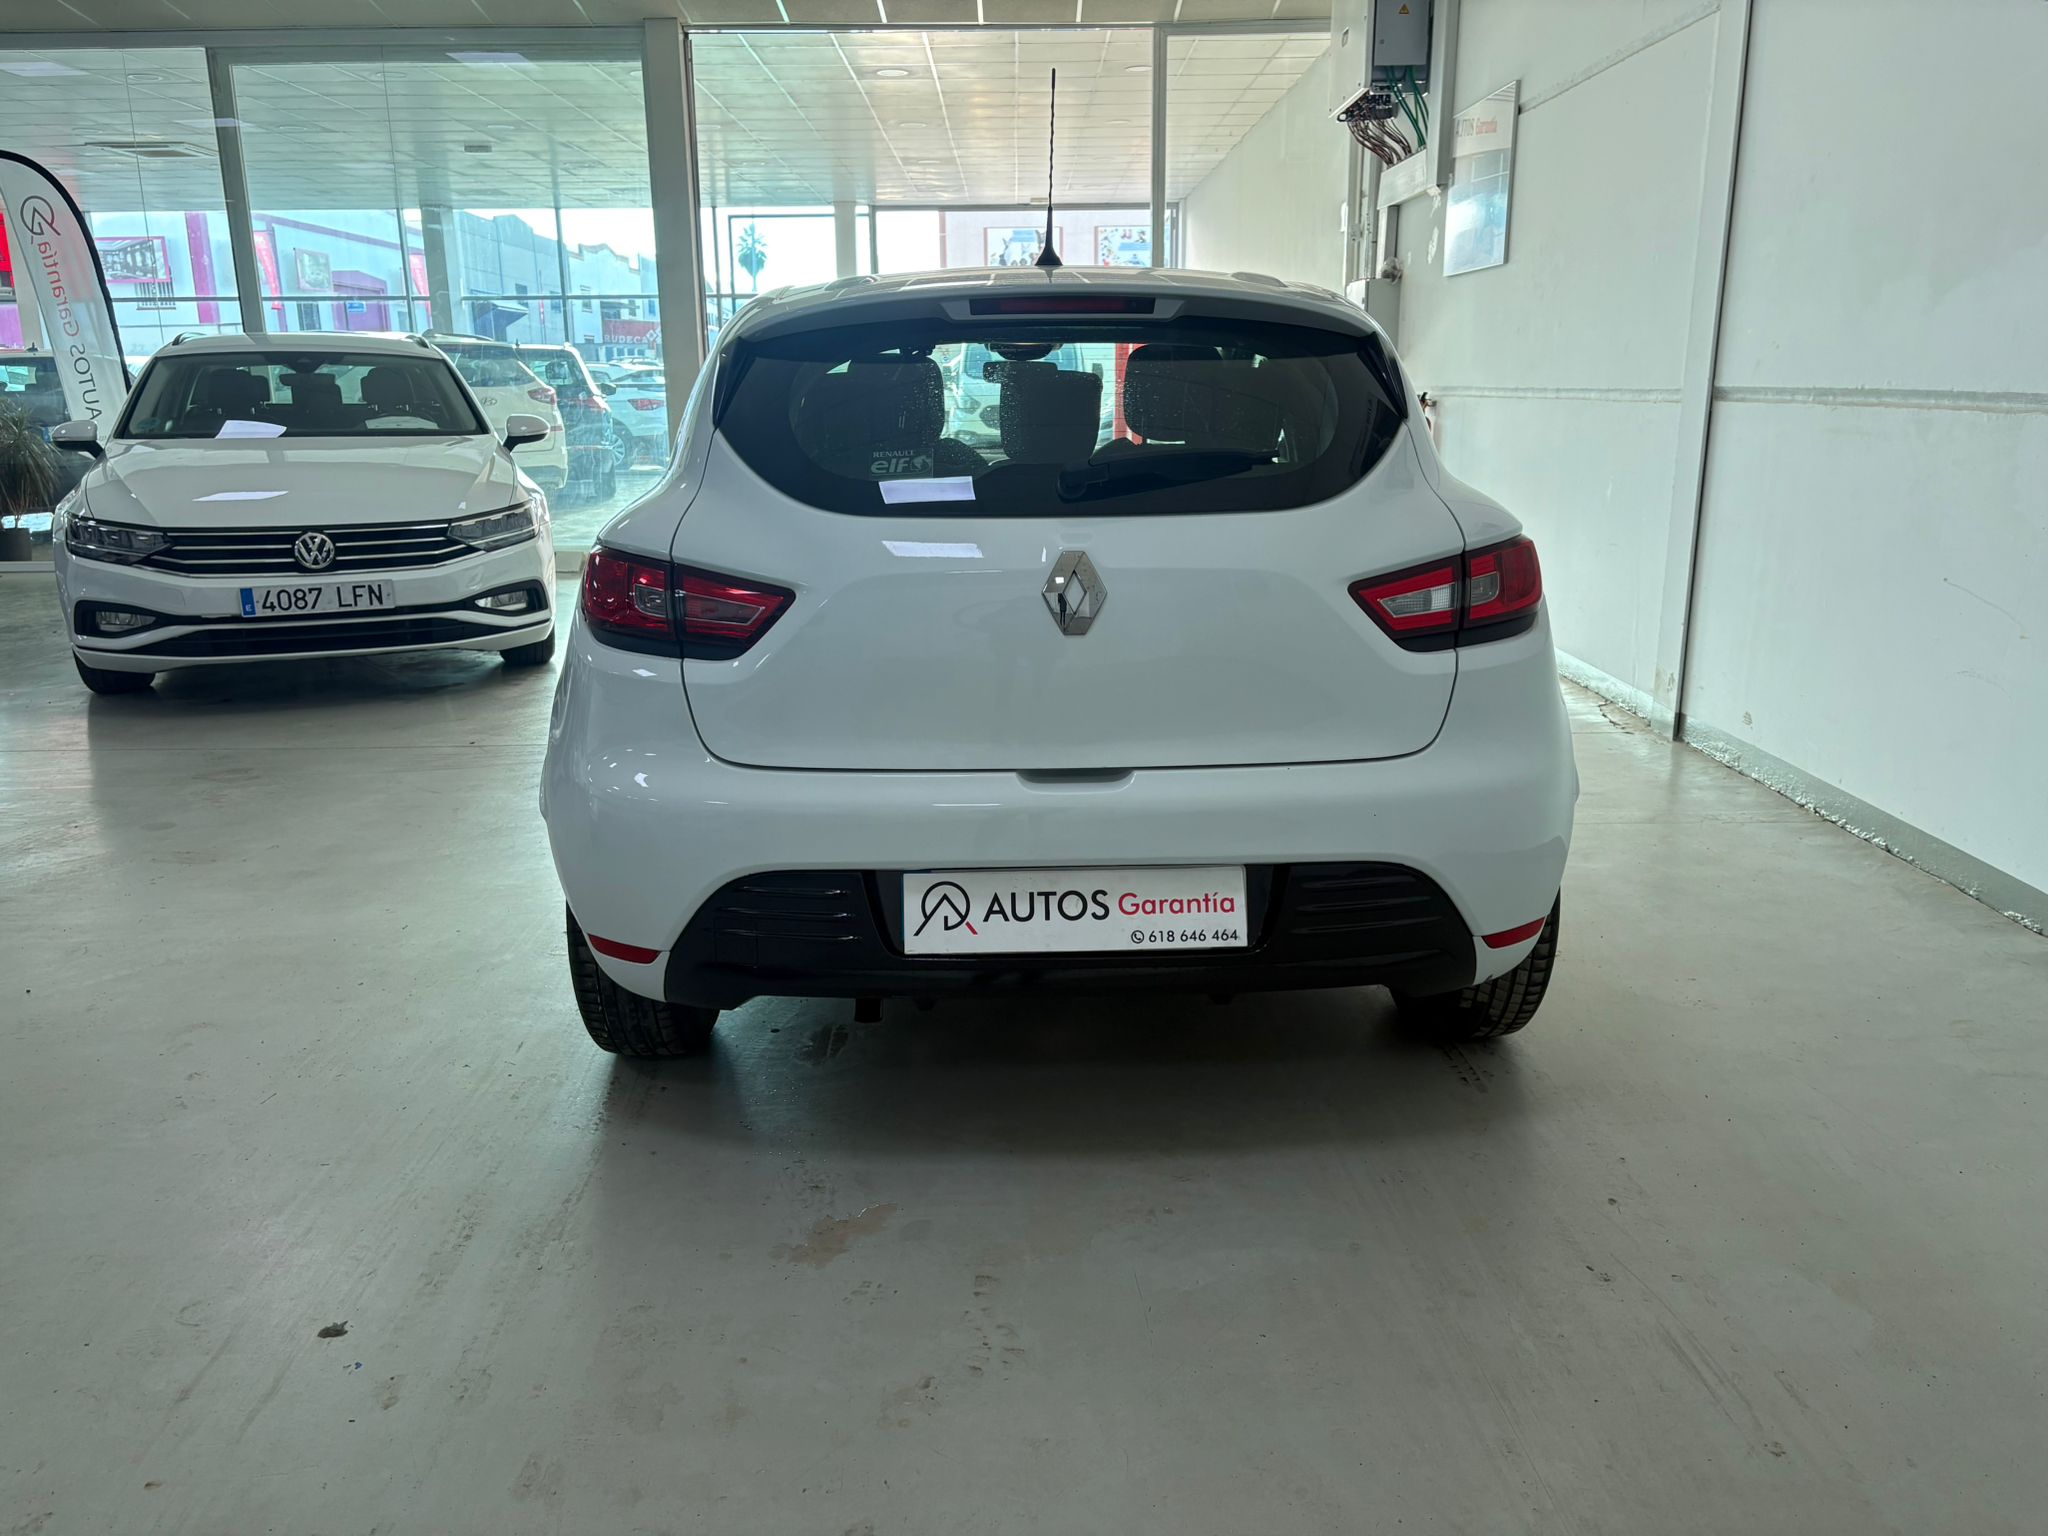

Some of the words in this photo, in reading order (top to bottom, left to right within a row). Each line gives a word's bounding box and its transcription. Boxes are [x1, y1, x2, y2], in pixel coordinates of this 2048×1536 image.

[873, 450, 914, 458] RENAULT
[870, 458, 910, 474] elf
[261, 588, 322, 612] 4087
[336, 584, 384, 608] LFN
[983, 889, 1110, 923] AUTOS
[1118, 892, 1236, 916] Garantía
[1148, 930, 1176, 943] 618
[1180, 930, 1208, 943] 646
[1211, 929, 1239, 942] 464
